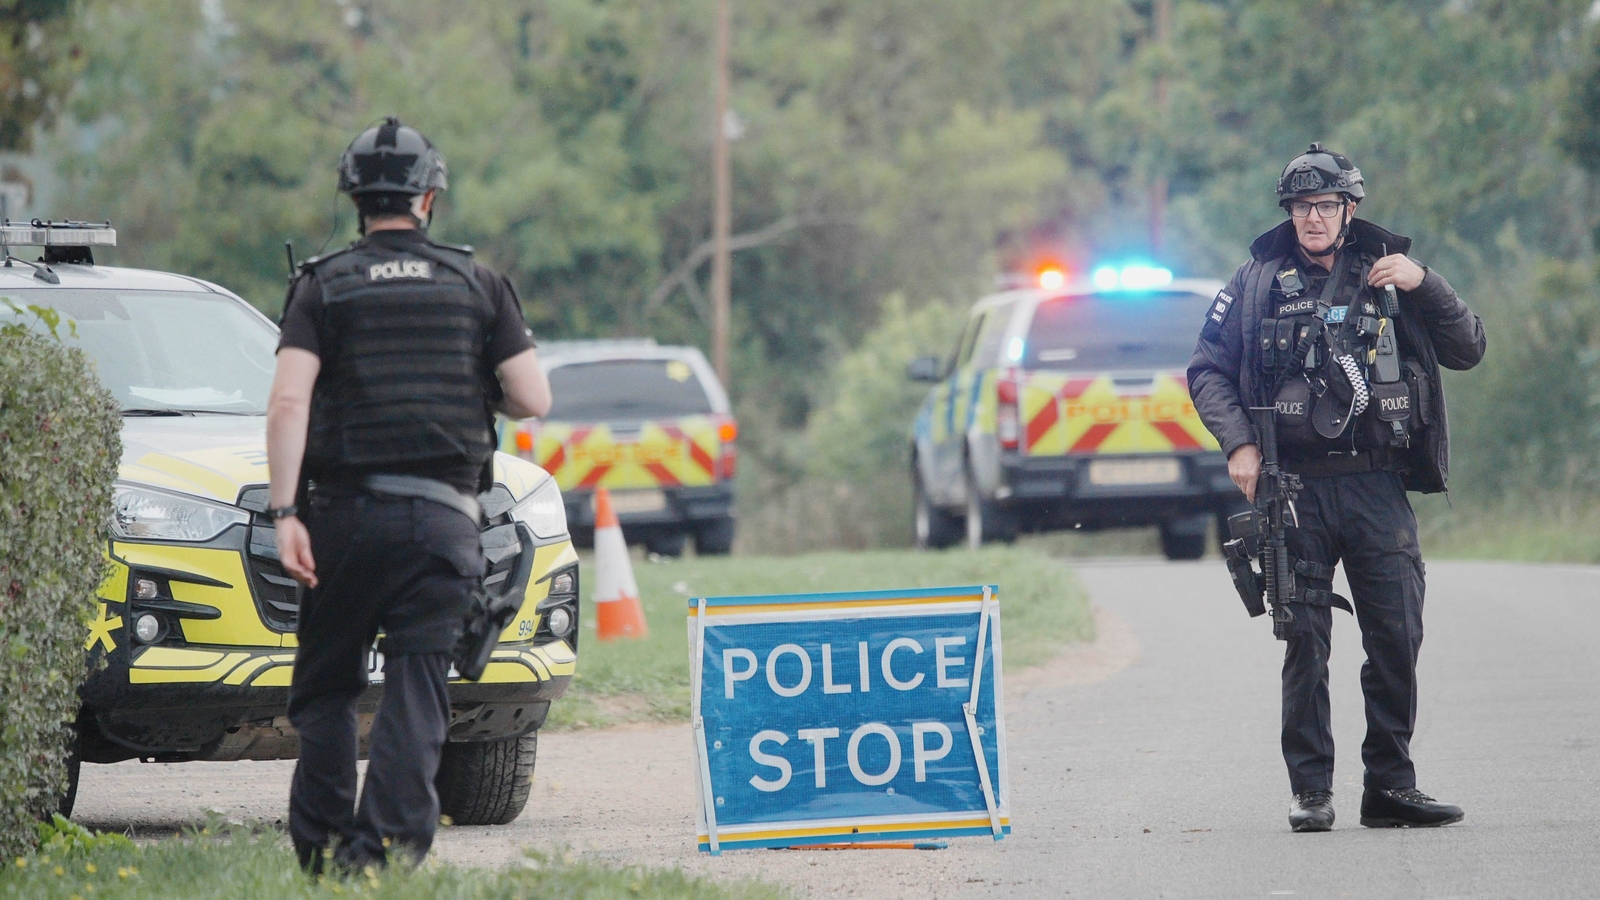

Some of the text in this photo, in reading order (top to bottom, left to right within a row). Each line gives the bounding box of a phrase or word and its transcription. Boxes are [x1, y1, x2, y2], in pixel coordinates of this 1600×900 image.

[369, 259, 431, 281] POLICE
[1218, 291, 1234, 304] POLICE
[1279, 300, 1314, 315] POLICE
[1274, 401, 1304, 415] POLICE
[1381, 396, 1410, 411] POLICE
[722, 636, 969, 700] POLICE
[749, 722, 953, 792] STOP
